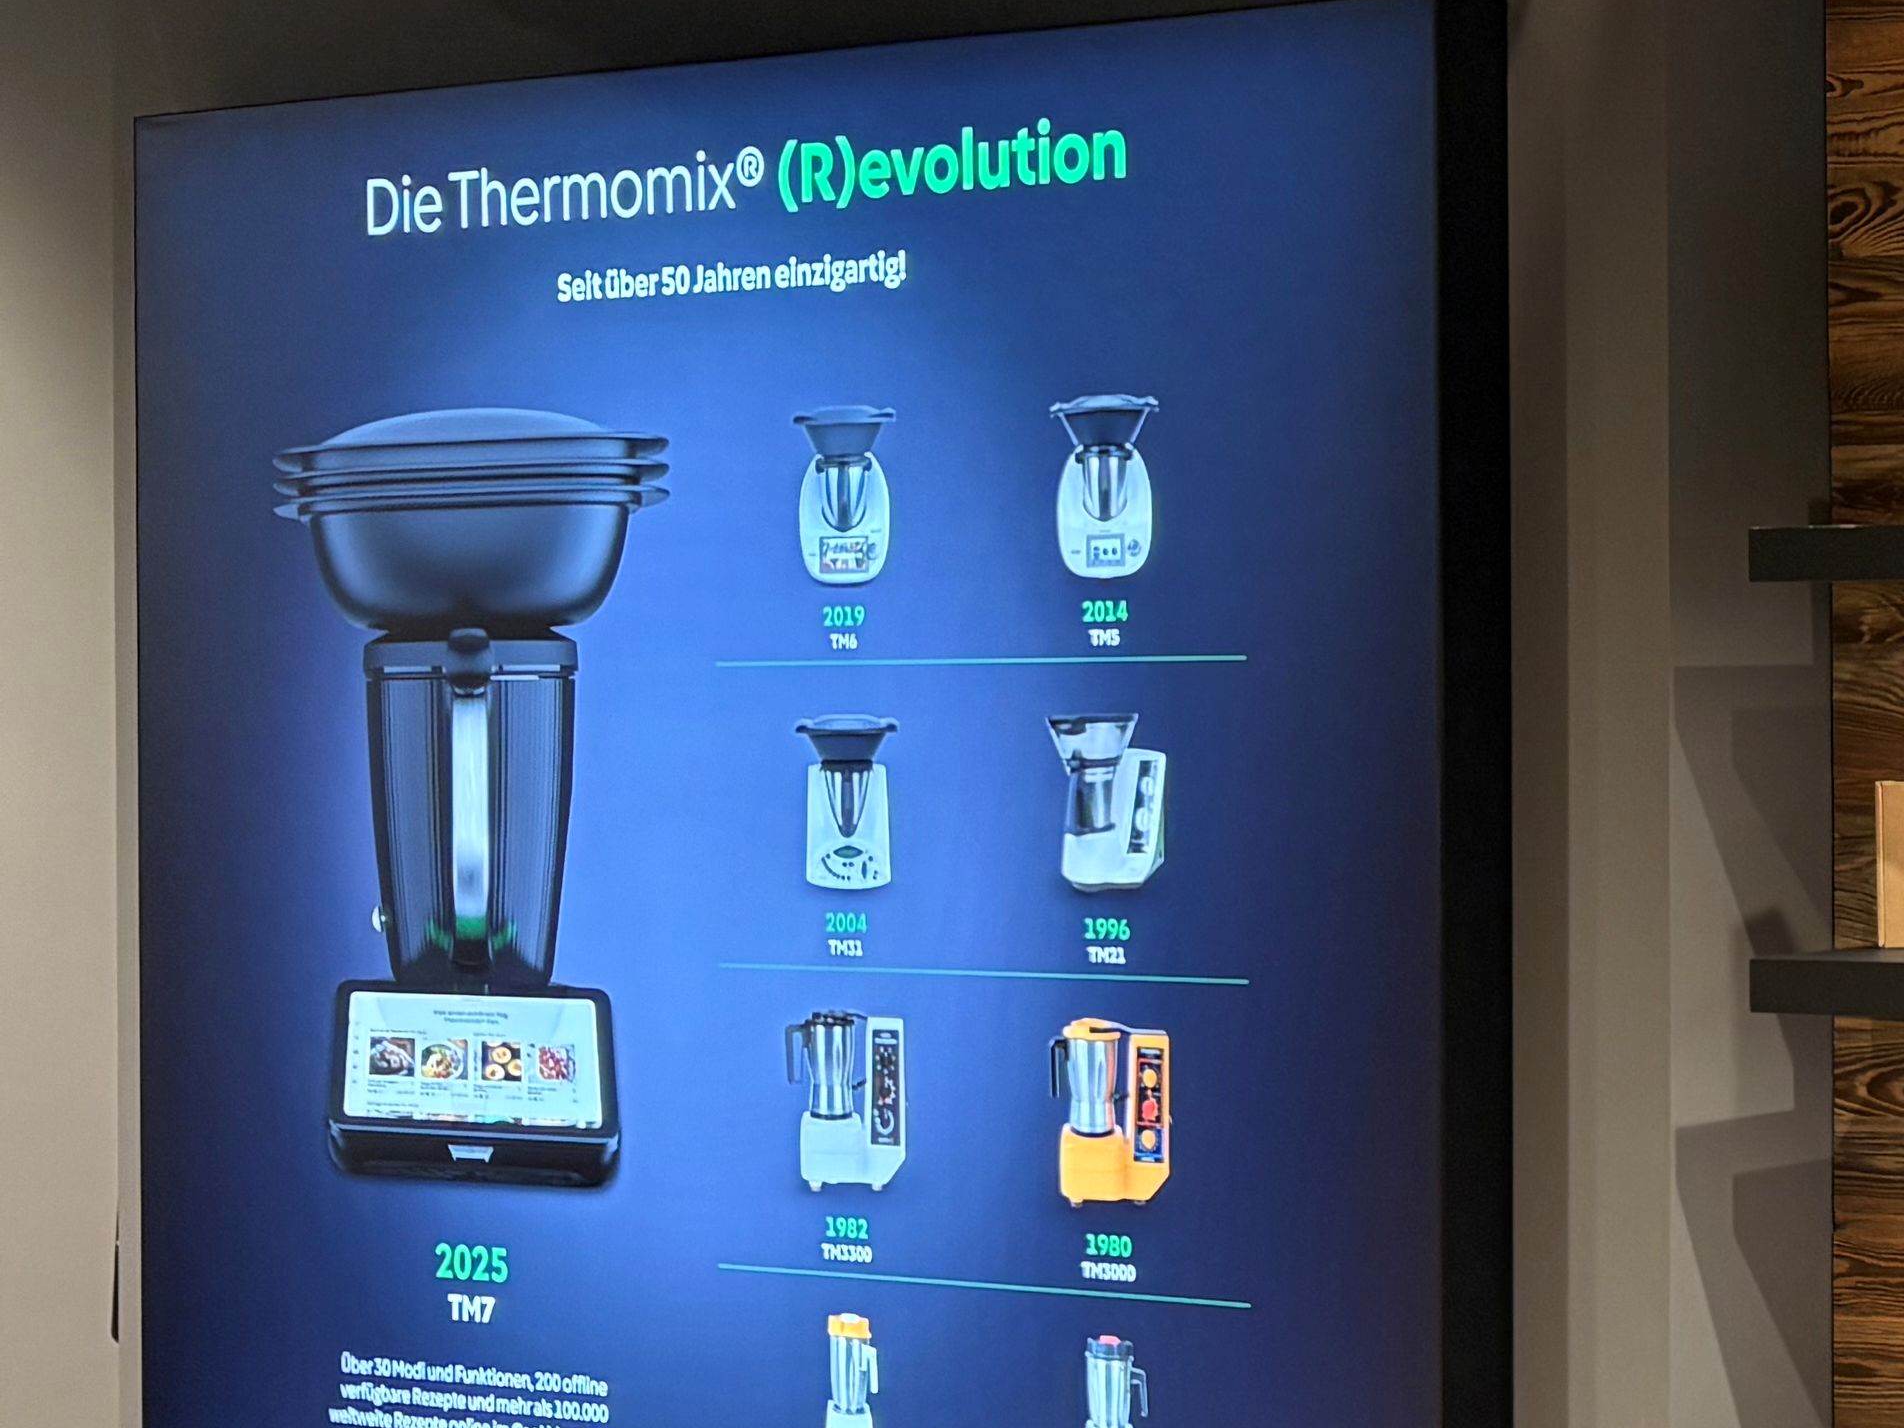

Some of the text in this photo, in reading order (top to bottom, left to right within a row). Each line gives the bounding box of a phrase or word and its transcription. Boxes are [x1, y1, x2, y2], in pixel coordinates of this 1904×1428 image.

[366, 117, 1127, 236] Die Thermomix® (R)evolution
[557, 249, 907, 303] Seit über 50 Jahren einzigartig!
[822, 605, 866, 628] 2019
[1081, 599, 1129, 623] 2014
[828, 632, 858, 651] TM6
[1087, 628, 1121, 647] TM5
[824, 911, 868, 934] 2004
[1082, 917, 1132, 942] 1996
[827, 938, 864, 958] TM31
[1085, 945, 1127, 966] TM21
[825, 1215, 870, 1241] 1982
[820, 1242, 874, 1264] TM3300
[1084, 1232, 1134, 1259] 1980
[434, 1242, 510, 1284] 2025
[1080, 1260, 1137, 1283] TM3000
[446, 1292, 497, 1325] TM7
[340, 1350, 609, 1398] Über 30 Modi und Funktionen, 200 offline
[340, 1381, 610, 1424] verfügbare Rezepte und mehr als 100.000
